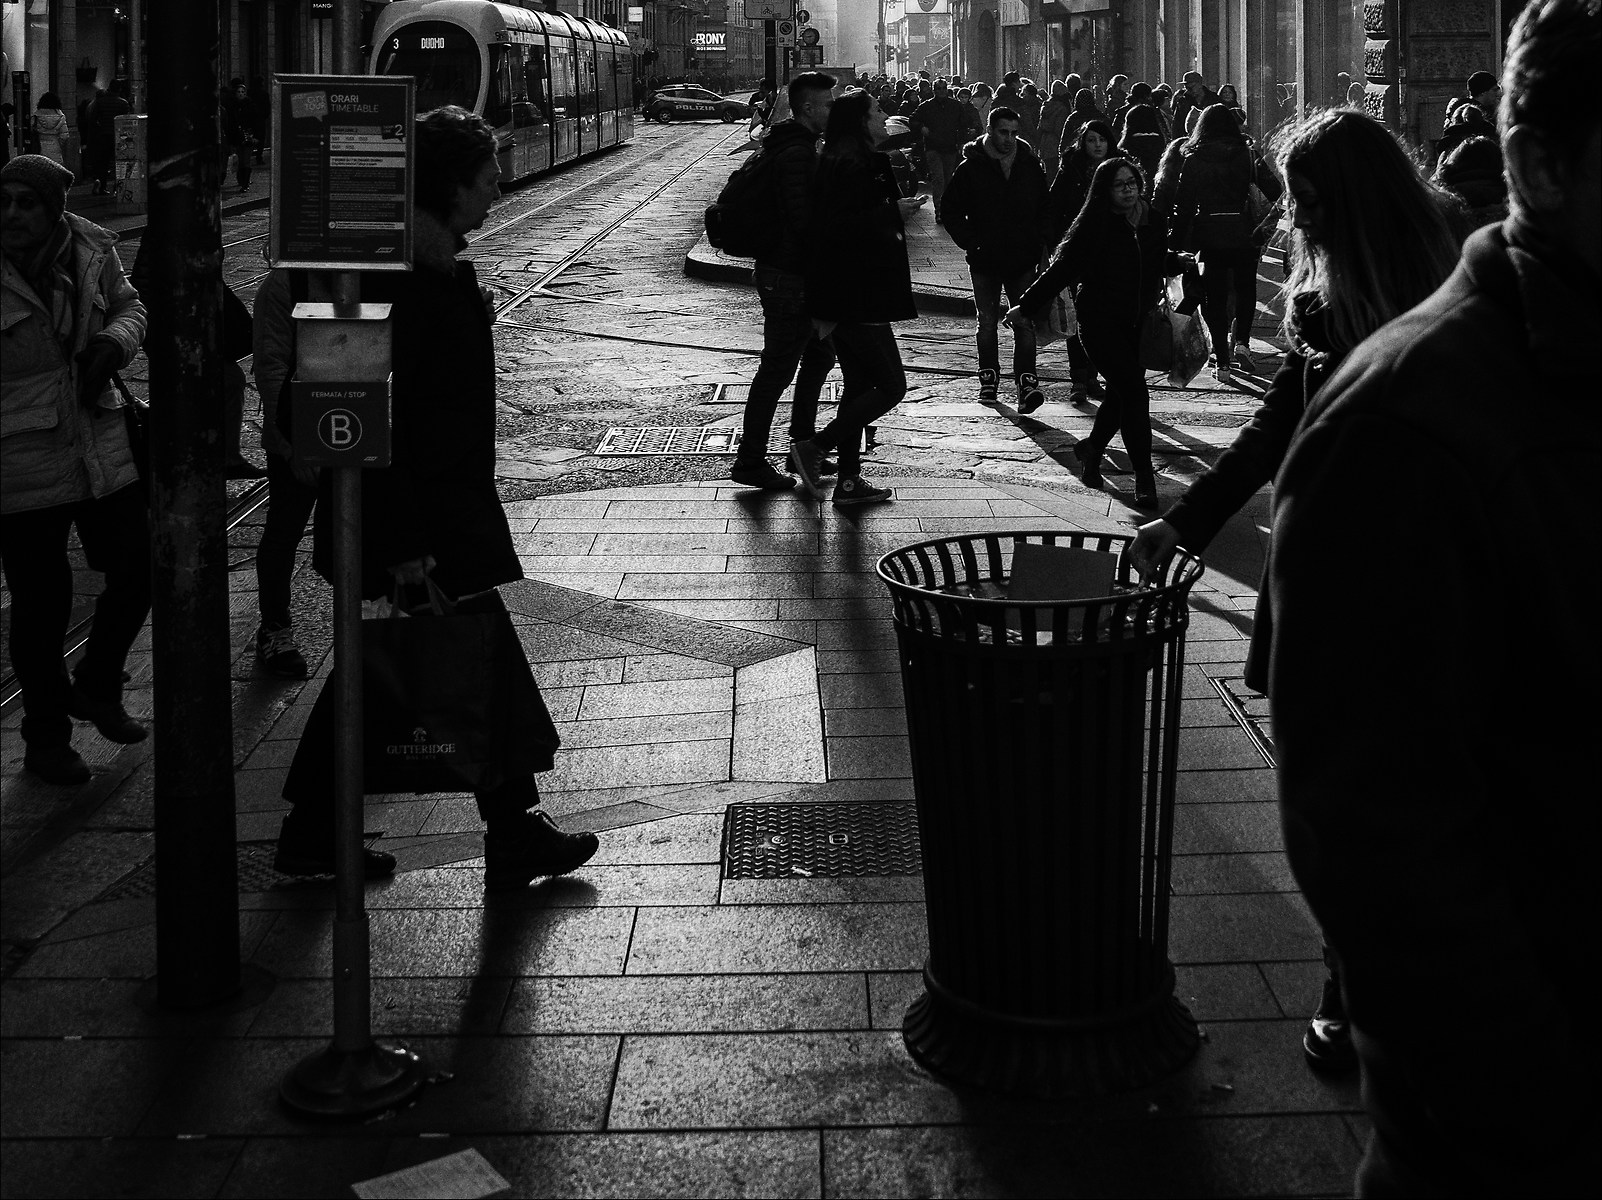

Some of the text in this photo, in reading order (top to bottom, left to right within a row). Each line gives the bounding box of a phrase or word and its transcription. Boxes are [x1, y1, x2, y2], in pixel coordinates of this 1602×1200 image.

[393, 37, 445, 49] 3 DUOMO
[330, 94, 359, 103] ORARI
[331, 104, 380, 113] TIMETABLE
[394, 124, 404, 136] 2
[330, 414, 353, 445] B
[386, 743, 457, 755] GUTTERIDGE
